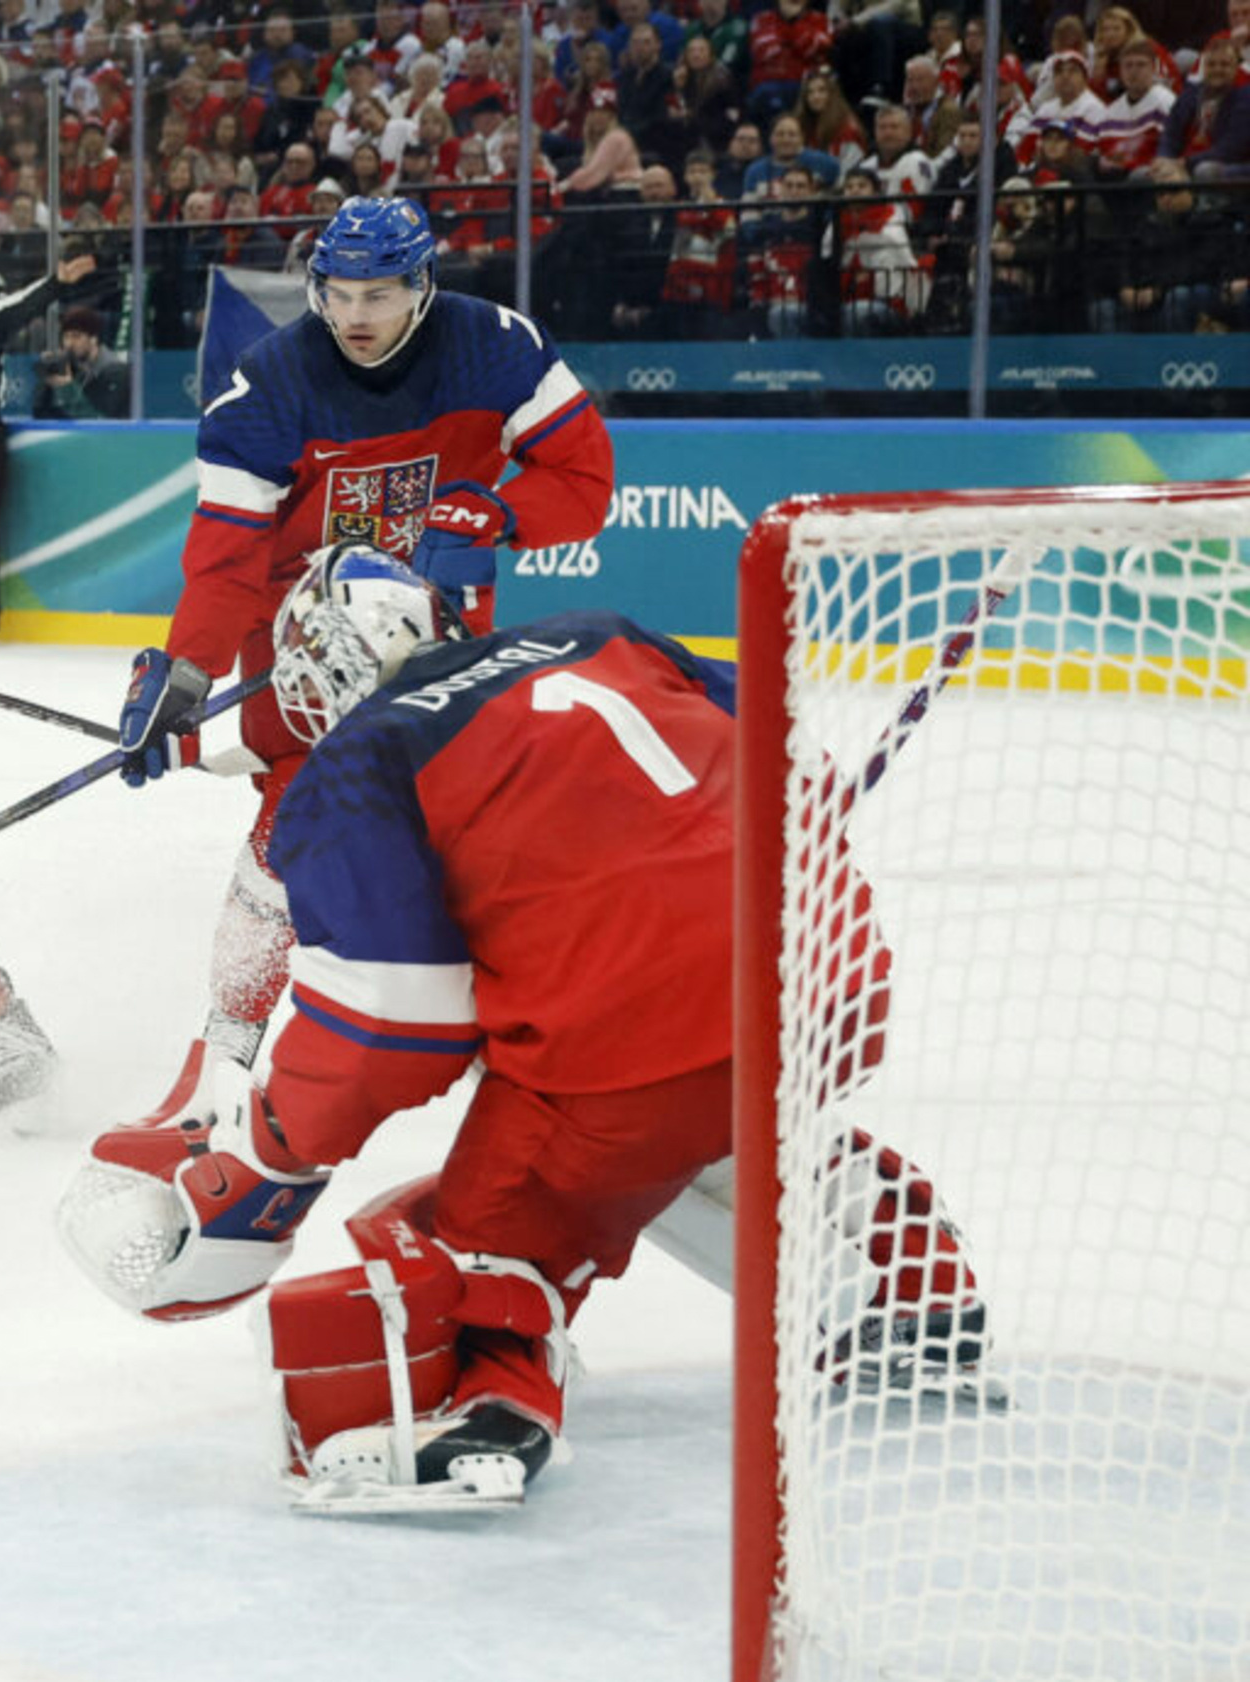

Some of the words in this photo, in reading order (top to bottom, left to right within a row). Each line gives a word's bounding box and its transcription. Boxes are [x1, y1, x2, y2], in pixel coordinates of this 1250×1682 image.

[497, 305, 543, 350] 7
[204, 368, 250, 417] 7
[429, 504, 489, 529] CM
[514, 538, 600, 578] 2026
[531, 670, 698, 798] 1
